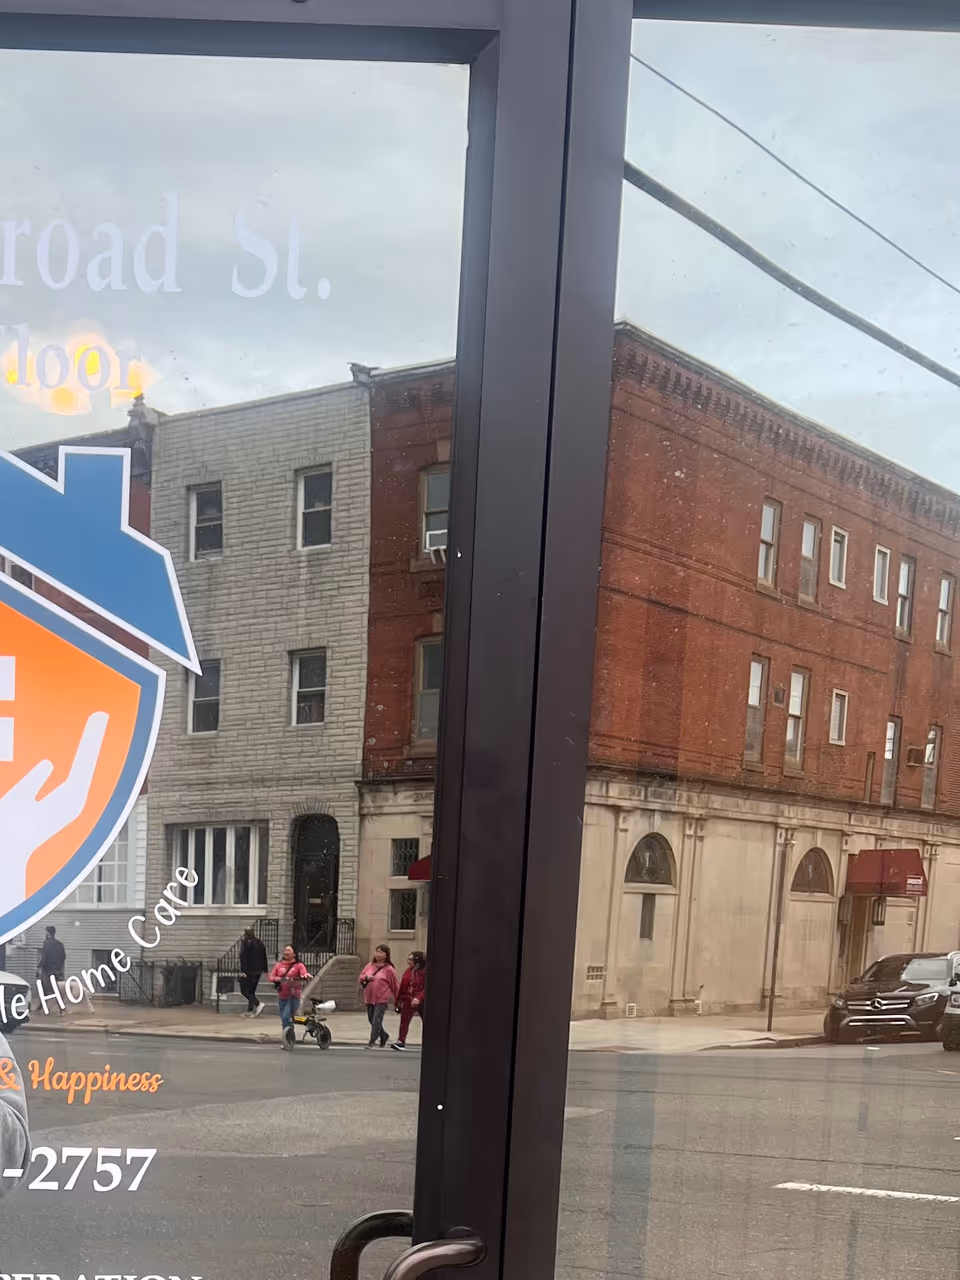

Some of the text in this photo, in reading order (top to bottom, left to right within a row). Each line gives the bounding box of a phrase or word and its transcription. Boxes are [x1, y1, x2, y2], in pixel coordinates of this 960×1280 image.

[231, 194, 332, 299] St.
[36, 948, 131, 1015] Home
[128, 866, 199, 948] Care
[28, 1057, 165, 1105] Happiness
